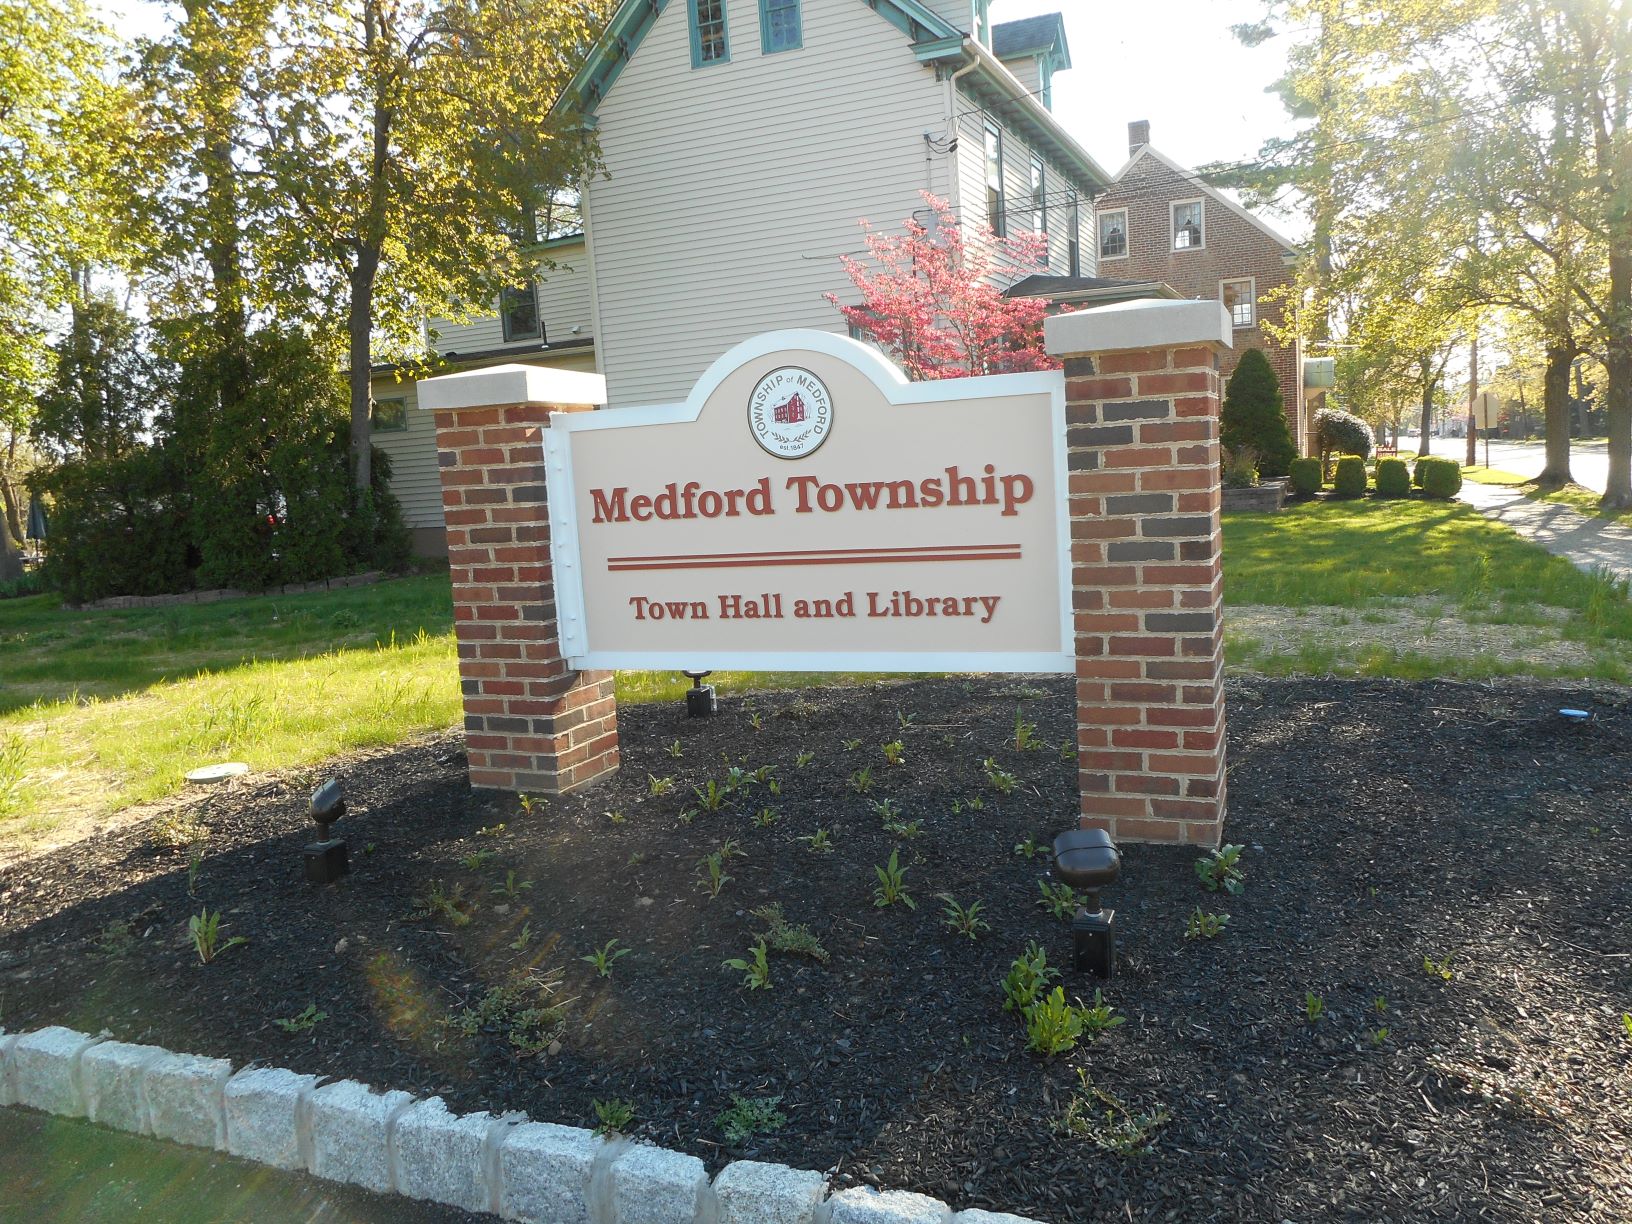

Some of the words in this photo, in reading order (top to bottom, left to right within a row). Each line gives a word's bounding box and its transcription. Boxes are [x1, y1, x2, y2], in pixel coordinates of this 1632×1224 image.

[754, 375, 784, 440] TOWNSHIP
[797, 375, 828, 435] MEDFORD
[590, 477, 775, 524] Medford
[786, 464, 1034, 517] Township
[629, 596, 709, 620] Town
[718, 594, 784, 619] Hall
[793, 591, 855, 618] and
[867, 590, 1001, 624] Library
